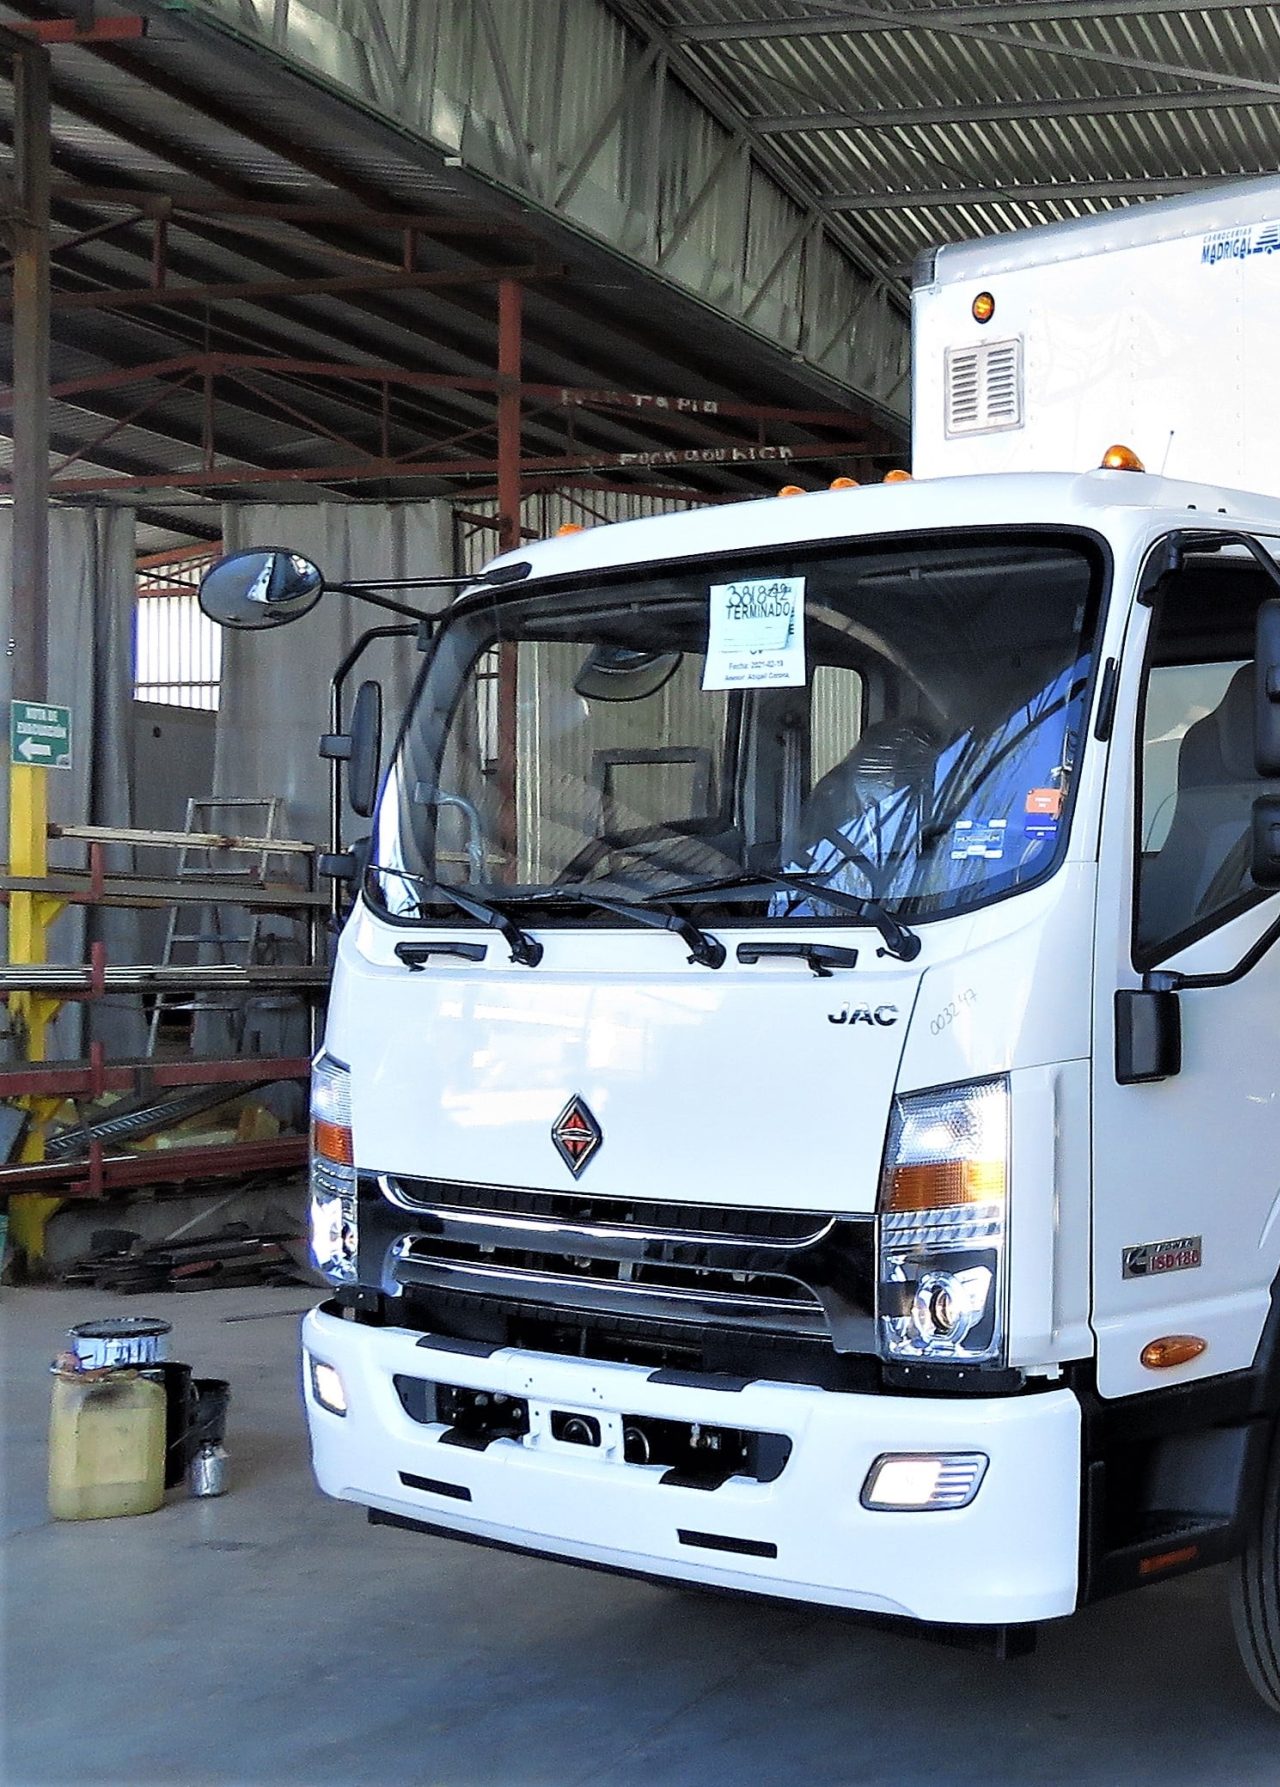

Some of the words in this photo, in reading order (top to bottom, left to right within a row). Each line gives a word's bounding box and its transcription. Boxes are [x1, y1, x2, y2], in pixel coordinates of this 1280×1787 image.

[1201, 237, 1252, 264] MADRIGAL
[726, 601, 791, 620] TERMINADO
[828, 1002, 899, 1026] JAC
